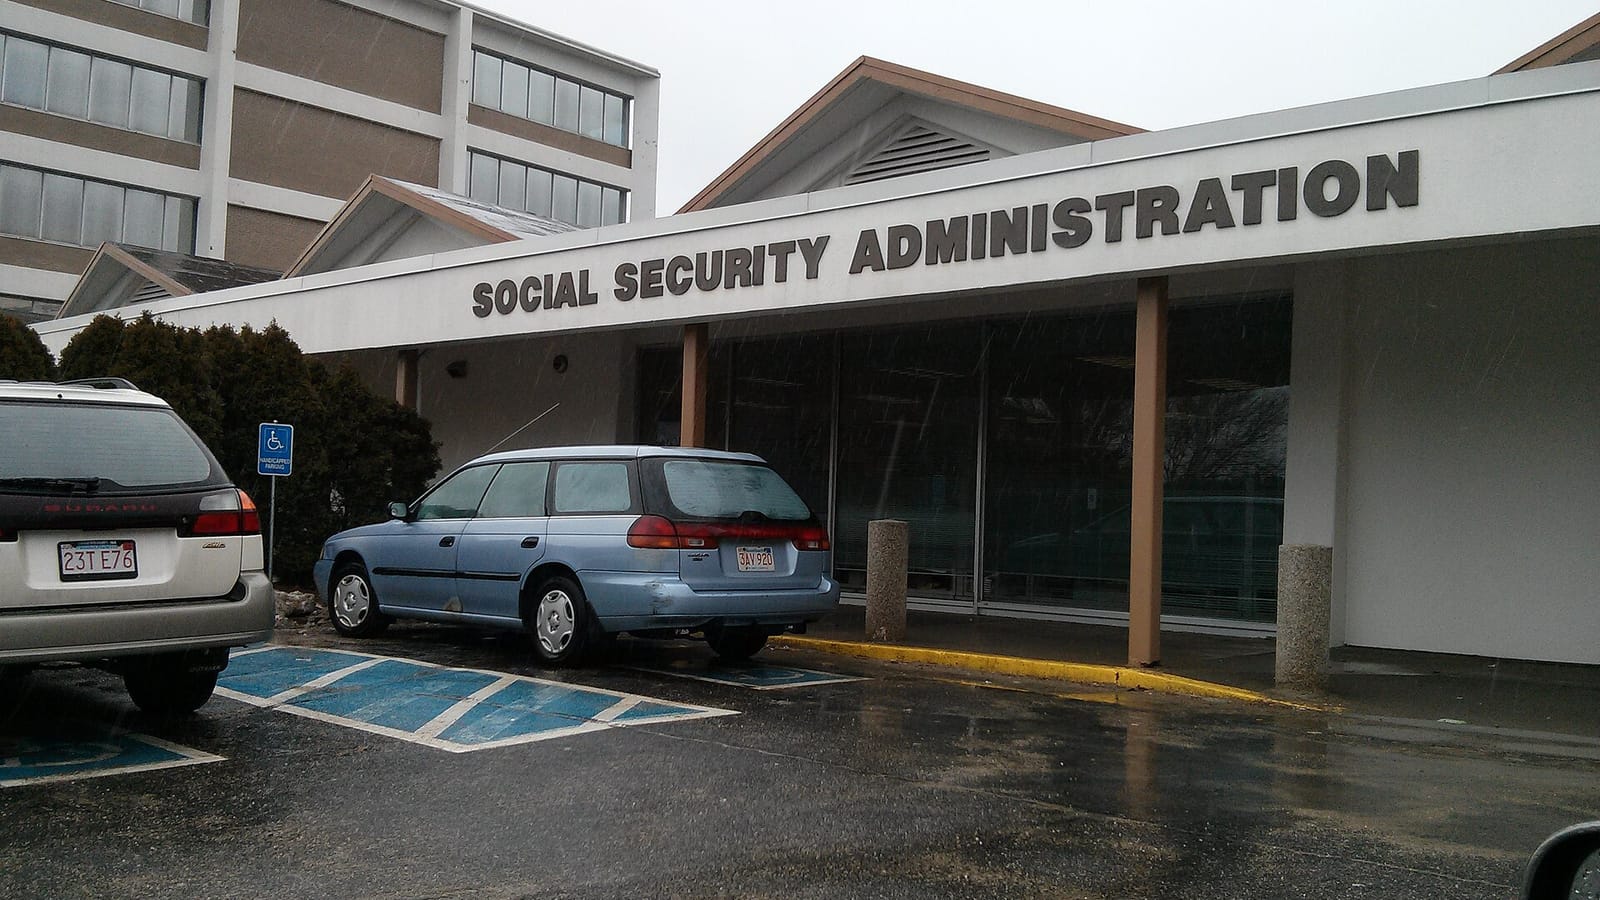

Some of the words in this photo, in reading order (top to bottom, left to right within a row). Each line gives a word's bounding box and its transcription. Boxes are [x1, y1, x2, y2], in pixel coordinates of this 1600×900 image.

[472, 269, 598, 318] SOCIAL
[613, 235, 831, 302] SECURITY
[848, 149, 1420, 275] ADMINISTRATION
[63, 551, 96, 571] 23T
[101, 550, 133, 570] E76
[756, 552, 773, 566] 920
